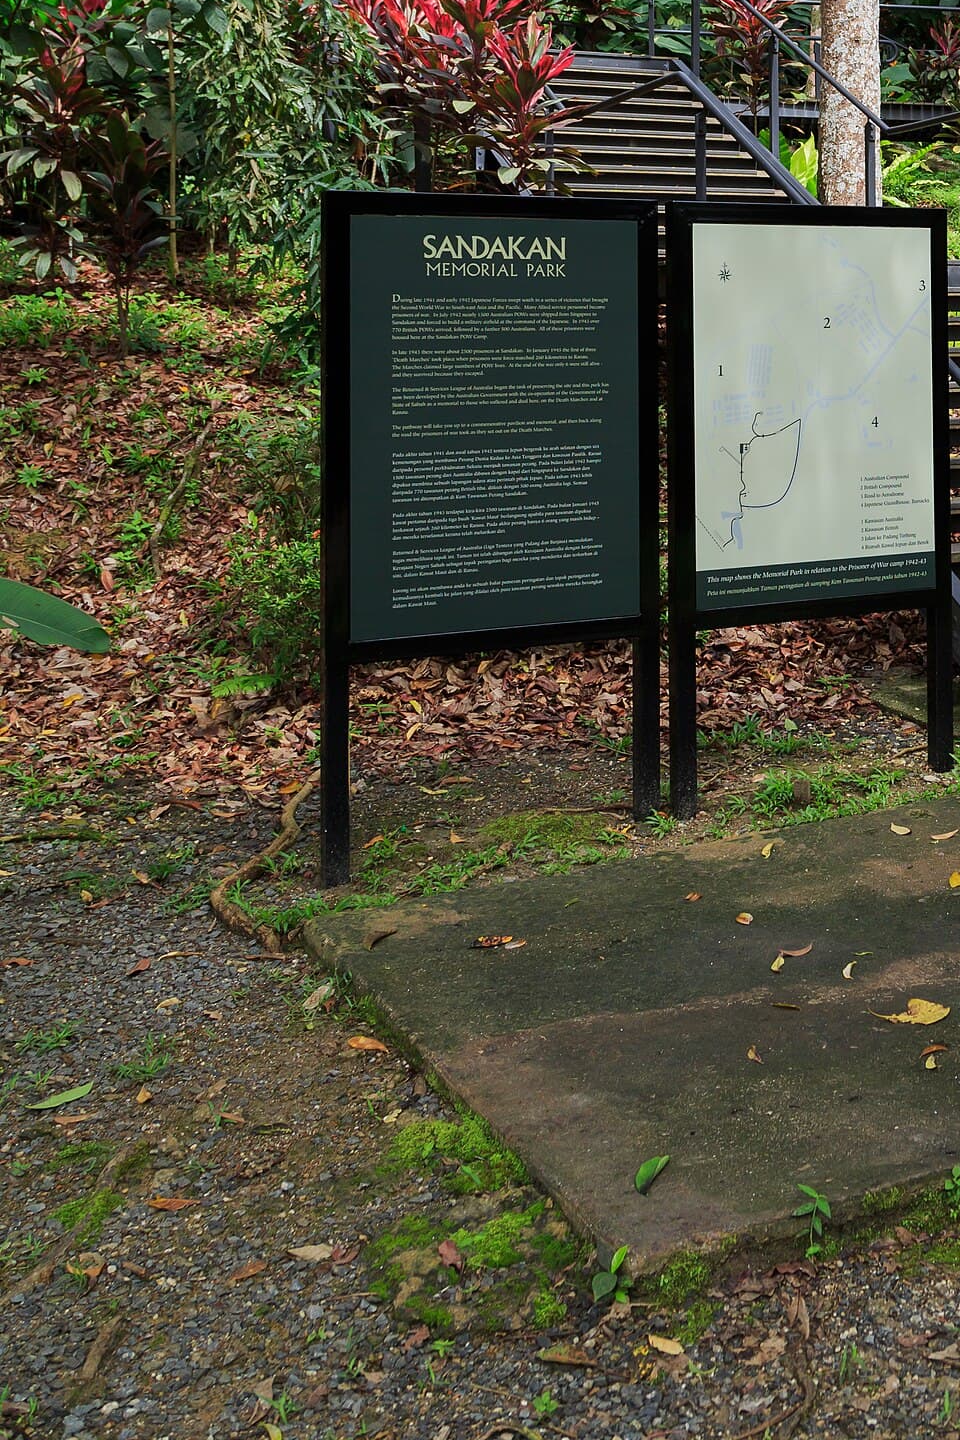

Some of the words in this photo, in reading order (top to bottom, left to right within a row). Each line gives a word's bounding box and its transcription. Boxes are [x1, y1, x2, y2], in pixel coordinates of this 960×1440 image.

[423, 235, 566, 260] SANDAKAN
[426, 263, 518, 277] MEMORIAL
[527, 264, 566, 277] PARK
[919, 280, 926, 291] 3
[824, 317, 831, 329] 2
[718, 365, 723, 376] 1
[871, 417, 878, 428] 4
[721, 575, 734, 583] map
[763, 570, 789, 578] Memorial
[811, 566, 831, 574] relation
[848, 563, 869, 571] Prisoner
